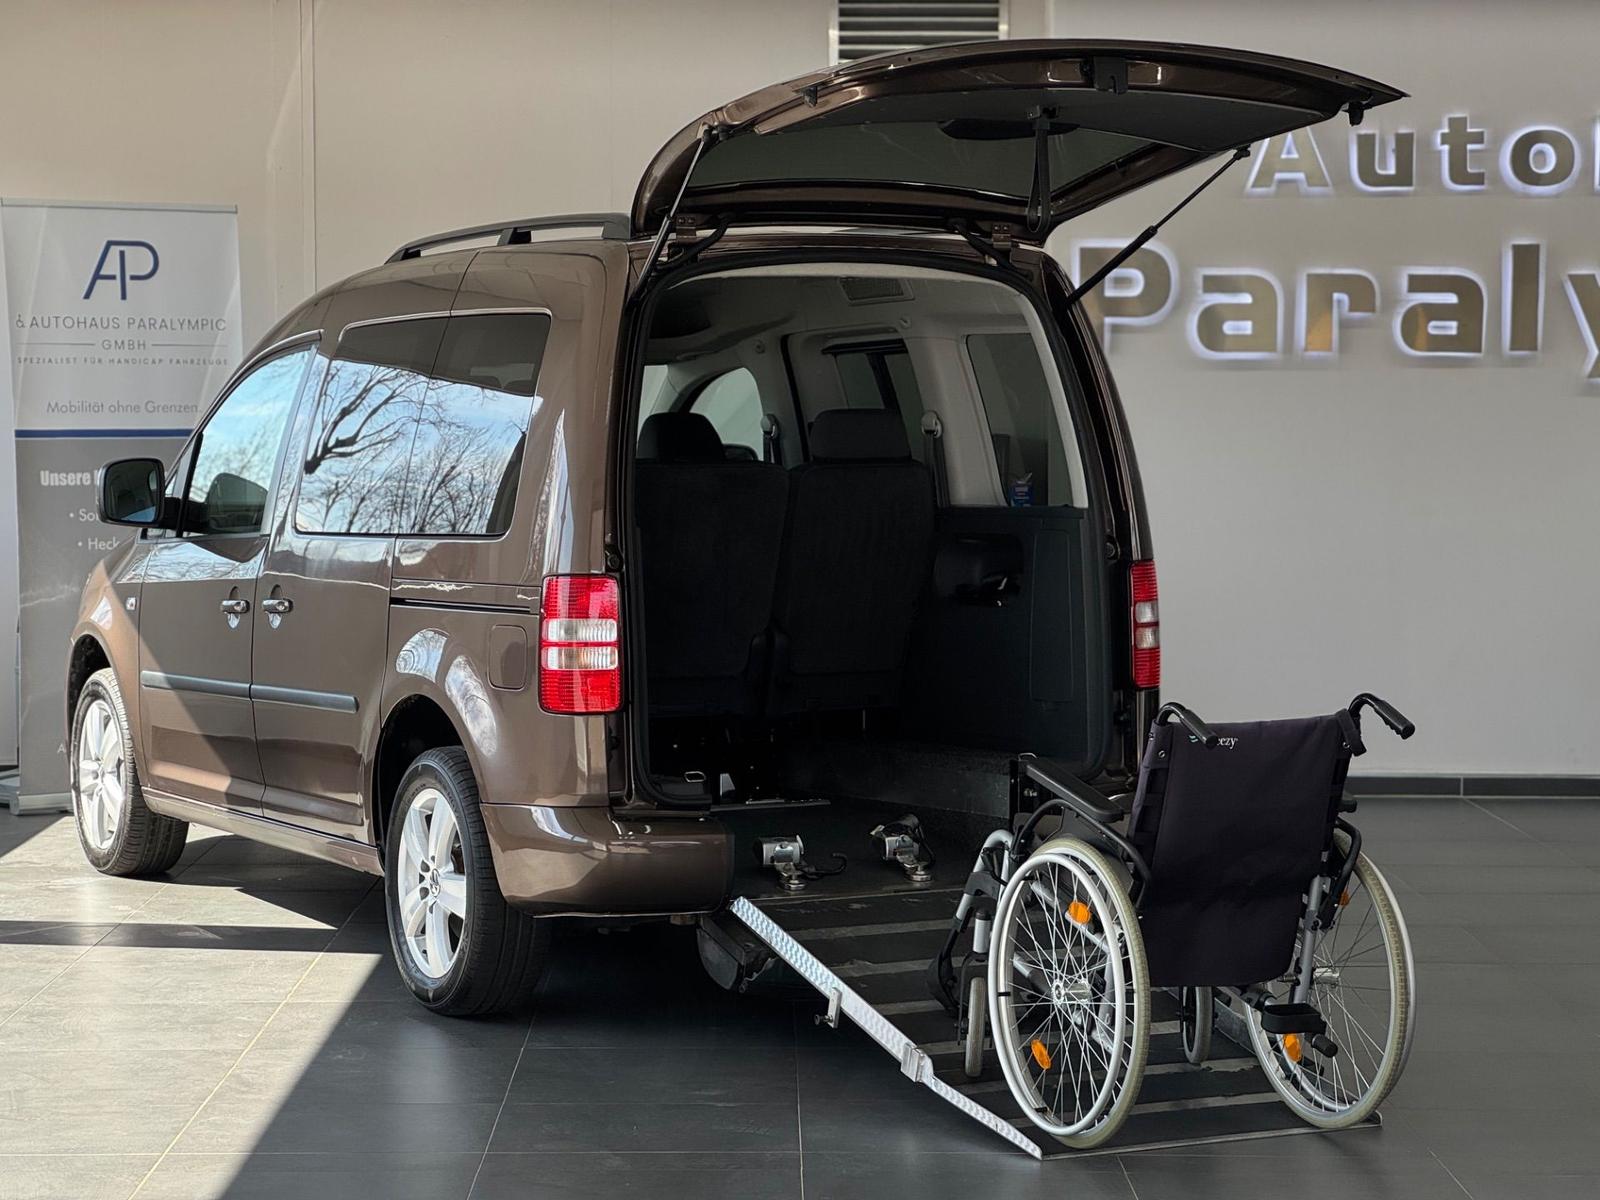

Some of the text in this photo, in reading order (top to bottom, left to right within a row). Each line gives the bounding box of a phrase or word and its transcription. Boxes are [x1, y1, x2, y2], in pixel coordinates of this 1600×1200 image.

[29, 316, 227, 332] AUTOHAUS PARALYMPIC
[101, 339, 147, 351] GMBH
[17, 356, 229, 366] SPEZIALIST FÜR HANDICAP FAHRZEUGE
[46, 400, 104, 414] Mobilität
[108, 401, 141, 414] ohne
[40, 470, 91, 486] Unsere
